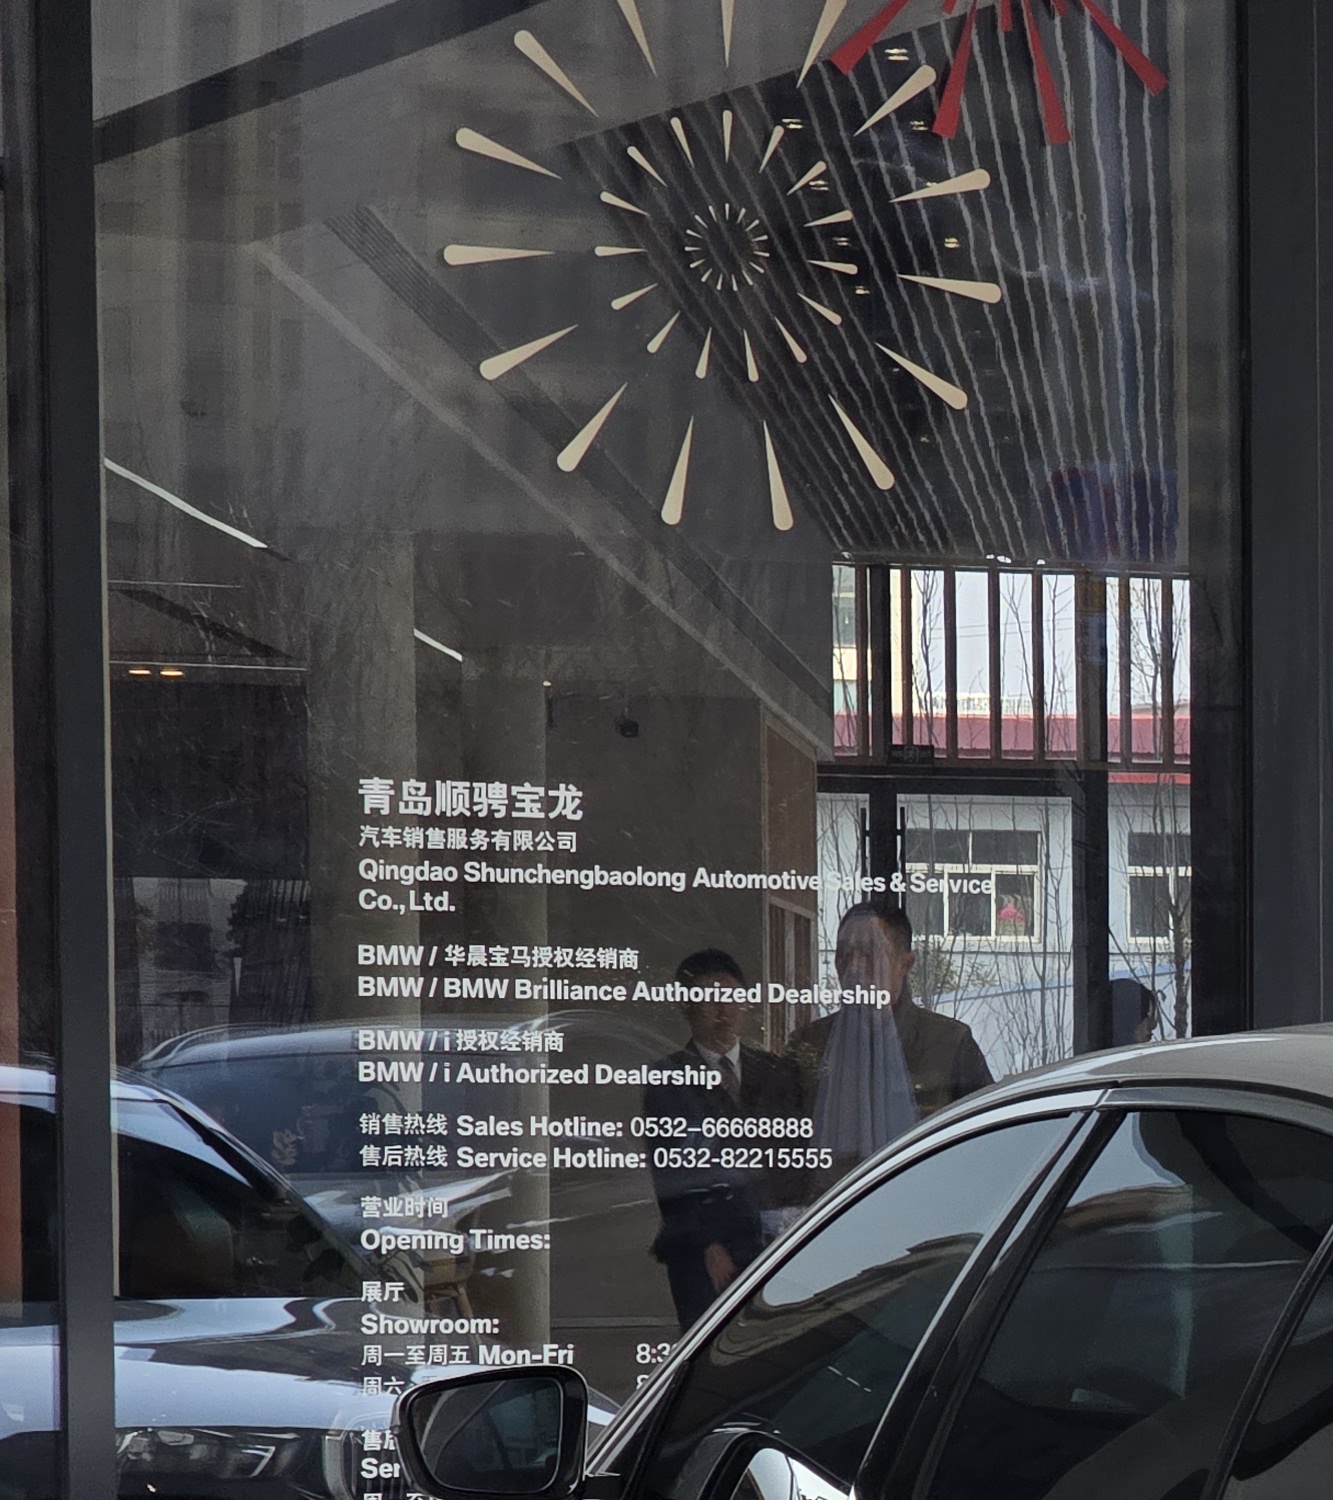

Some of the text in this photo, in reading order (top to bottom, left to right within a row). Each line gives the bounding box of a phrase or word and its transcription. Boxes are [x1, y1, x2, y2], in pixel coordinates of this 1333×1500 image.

[357, 777, 584, 820] 青岛顺骋宝龙
[358, 825, 577, 852] 汽车销售服务有限公司
[358, 858, 995, 895] Qingdao Shunchengbaolong Automotive Sales & Service
[358, 888, 456, 915] Co., Ltd.
[358, 944, 639, 970] BMW / 华晨宝马授权经销商
[358, 976, 892, 1008] BMW / BMW Brilliance Authorized Dealership
[358, 1029, 564, 1052] BMW / i 授权经销商
[358, 1061, 722, 1091] BMW / i Authorized Dealership
[359, 1113, 814, 1138] 销售热线 Sales Hotline: 0532-66668888
[359, 1144, 833, 1169] 售后热线 Service Hotline: 0532-82215555
[360, 1195, 449, 1219] 营业时间
[360, 1229, 551, 1255] Opening Times:
[361, 1281, 404, 1302] 展厅
[360, 1314, 500, 1335] Showroom:
[361, 1341, 677, 1366] 周一至周五 Mon-Fri 8:3
